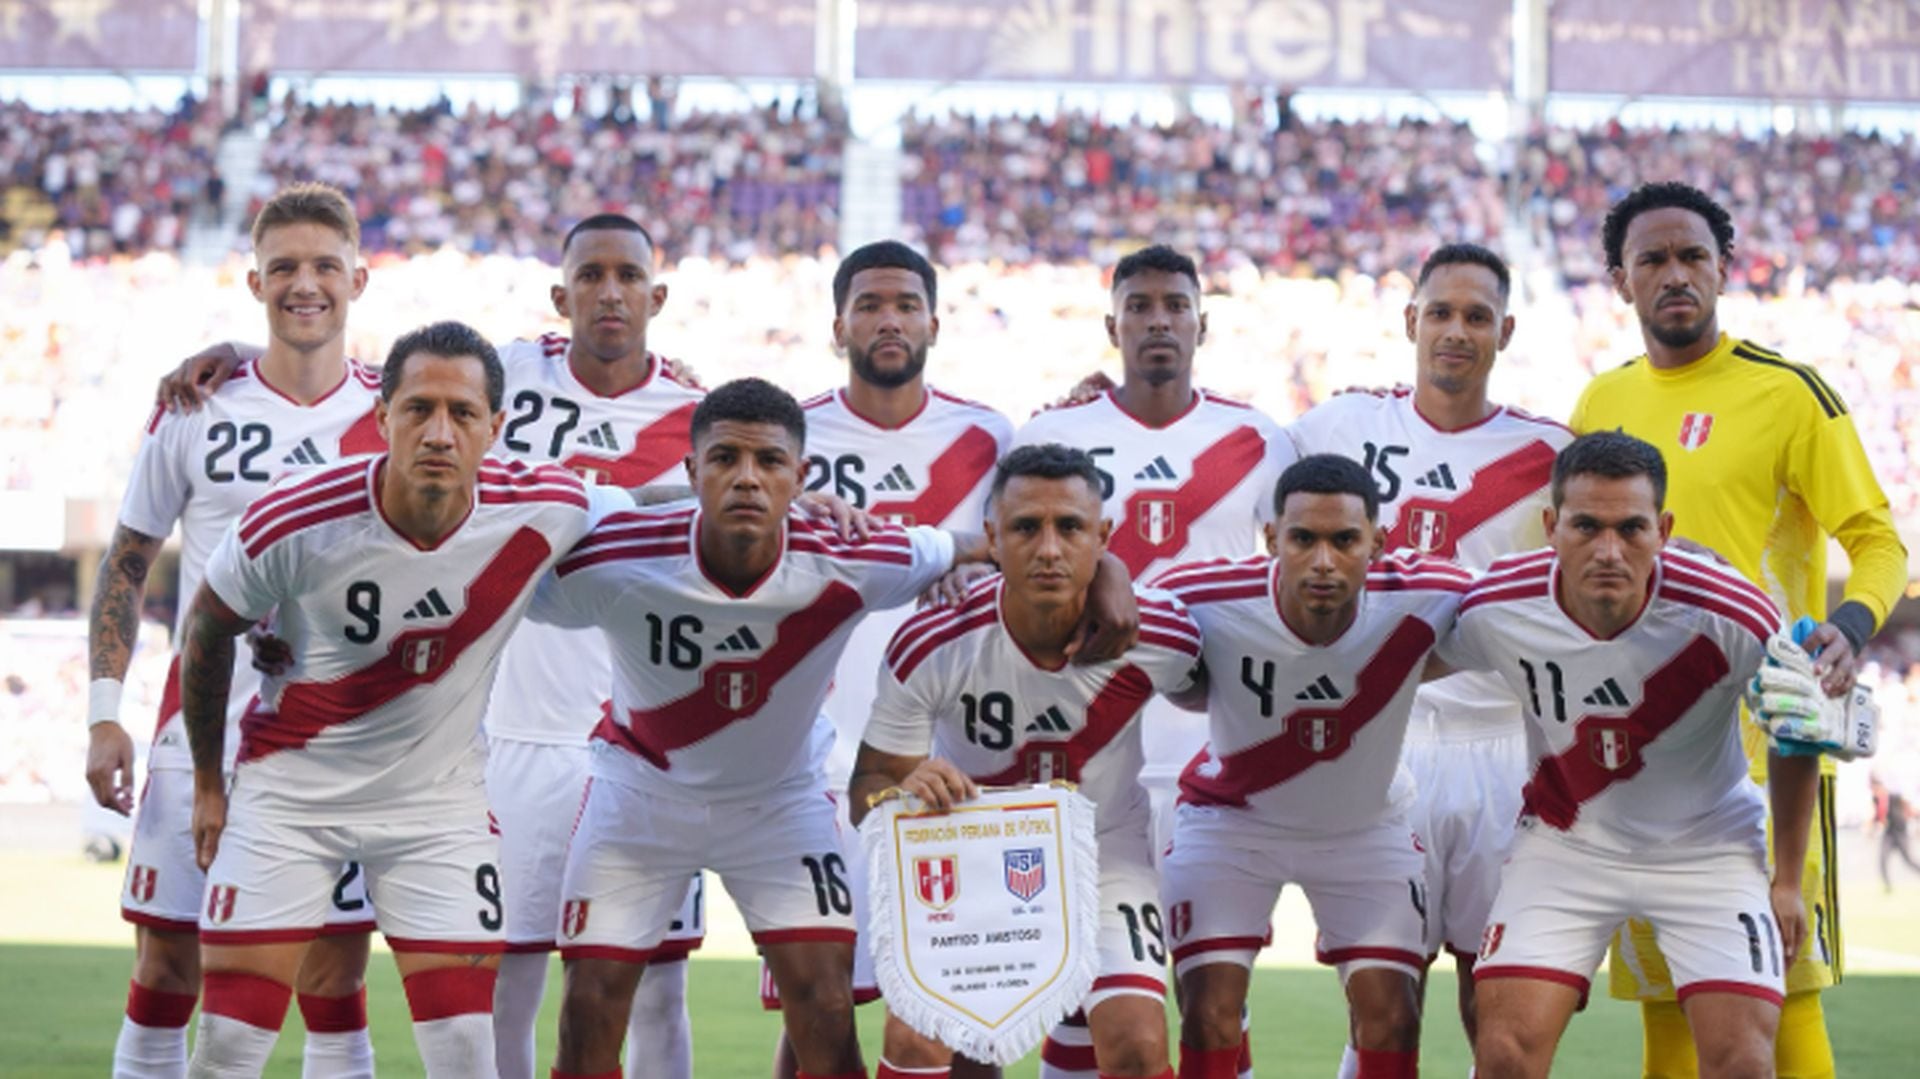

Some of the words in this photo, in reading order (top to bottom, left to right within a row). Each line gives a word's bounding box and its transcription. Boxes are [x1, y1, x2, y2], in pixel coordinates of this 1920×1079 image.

[205, 421, 272, 483] 22
[504, 389, 582, 459] 27
[804, 454, 867, 508] 26
[1362, 441, 1410, 503] 15
[343, 580, 382, 646] 9
[644, 611, 705, 671] 16
[1240, 655, 1277, 718] 4
[1517, 656, 1568, 725] 11
[959, 690, 1015, 752] 19
[331, 860, 375, 911] 2
[475, 863, 502, 931] 9
[802, 852, 852, 916] 16
[1117, 903, 1167, 966] 19
[1738, 911, 1780, 977] 11
